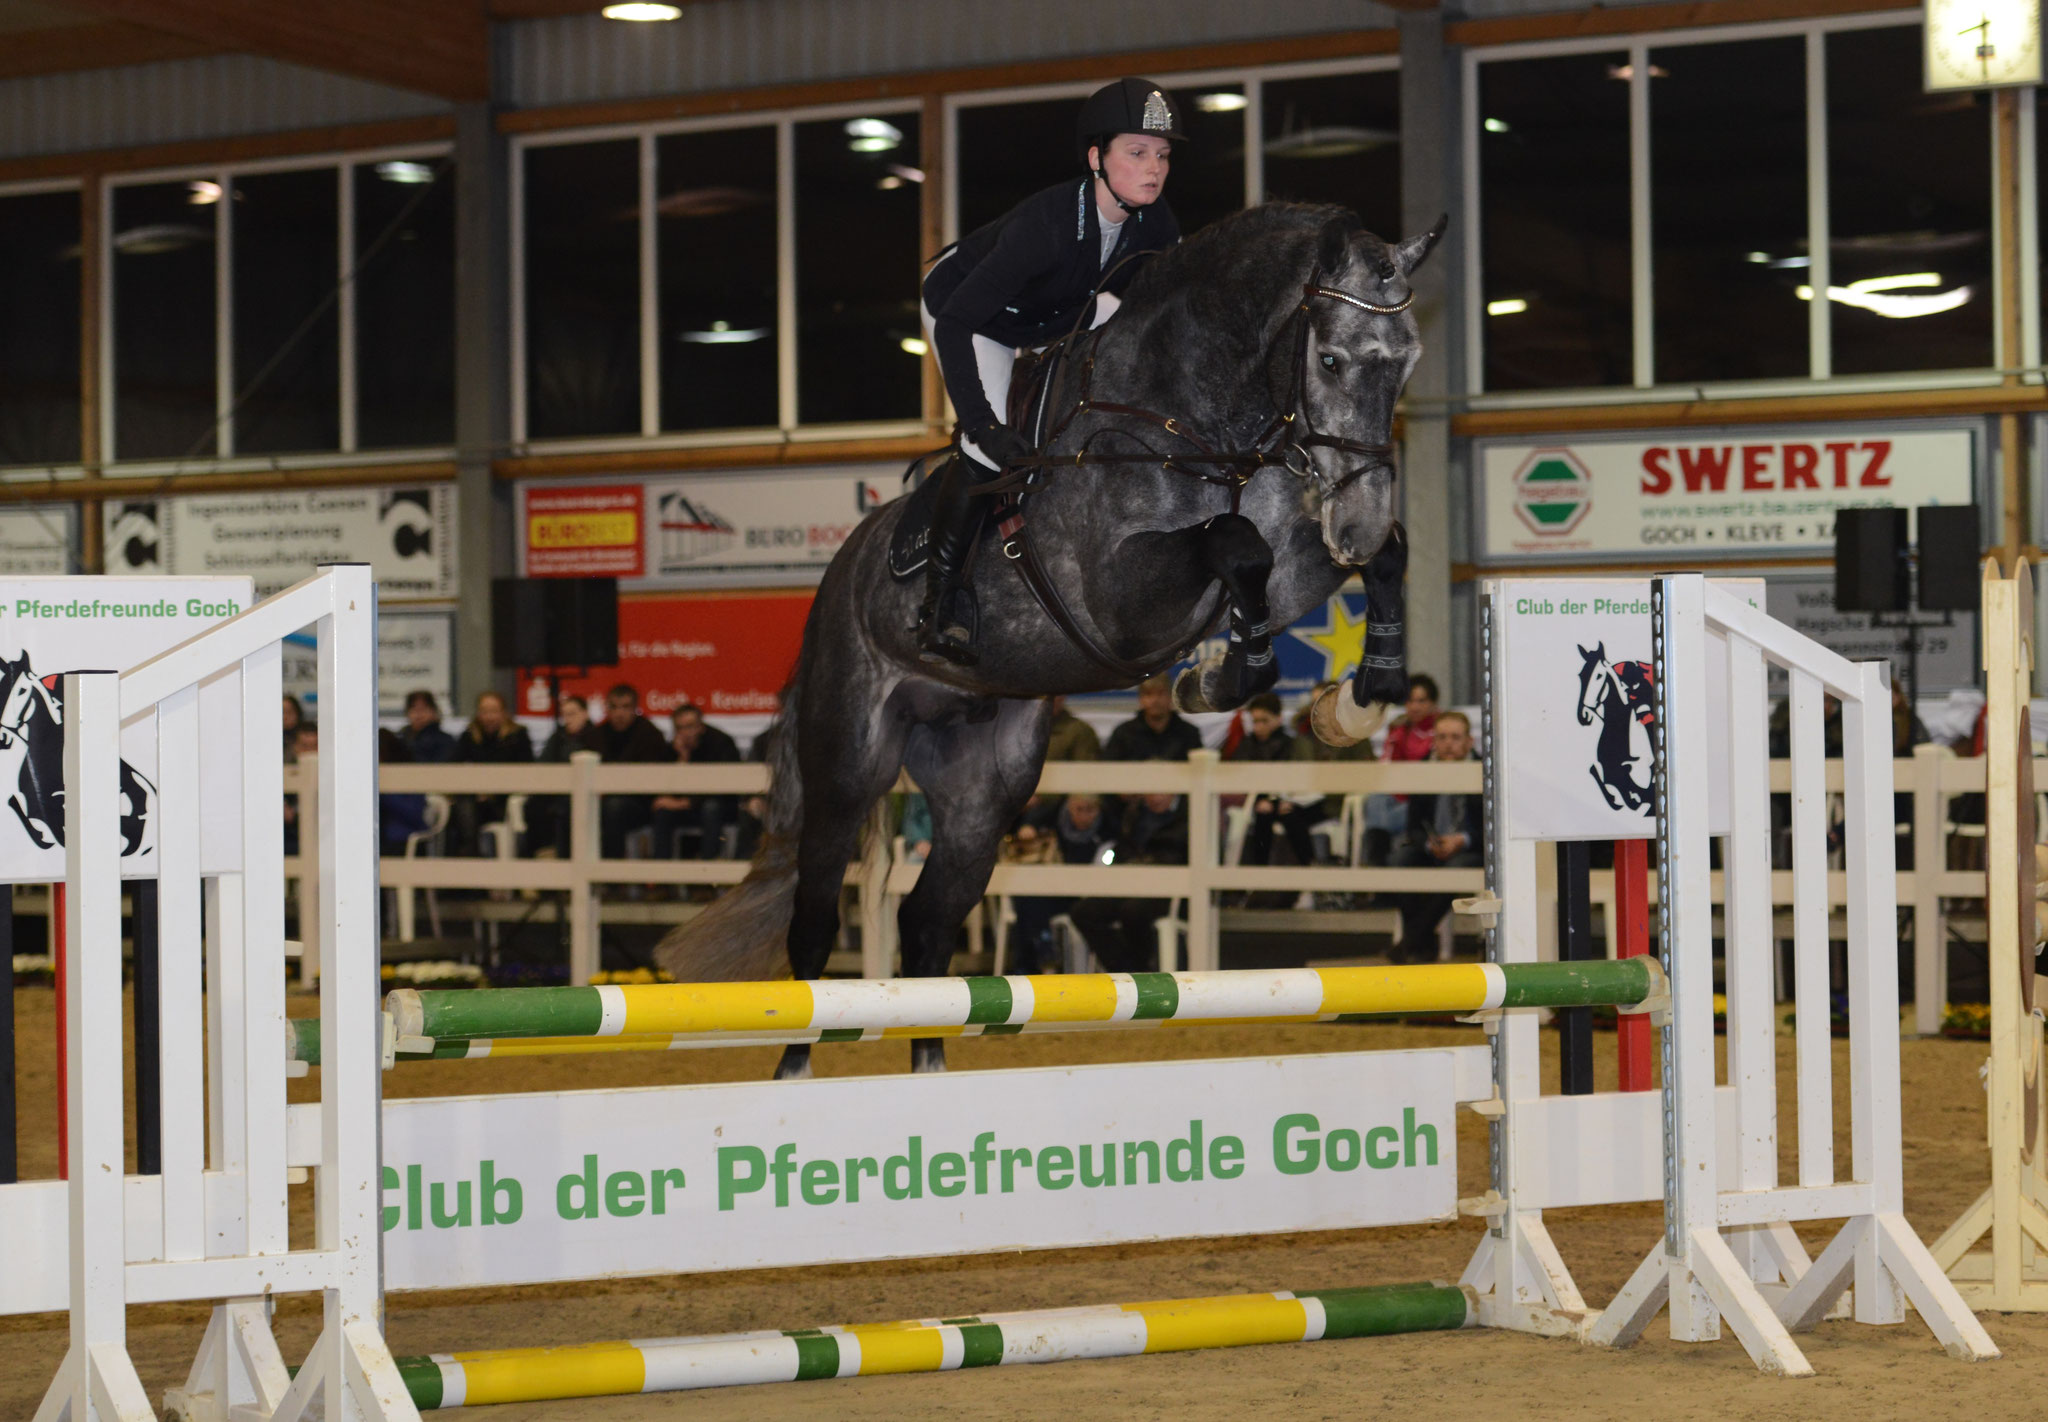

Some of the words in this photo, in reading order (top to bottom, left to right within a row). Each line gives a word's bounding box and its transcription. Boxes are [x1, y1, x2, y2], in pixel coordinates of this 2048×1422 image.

[1640, 440, 1893, 496] SWERTZ
[1641, 524, 1697, 545] GOCH
[1725, 521, 1785, 542] KLEVE
[15, 599, 178, 618] Pferdefreunde
[185, 598, 241, 617] Goch
[1516, 598, 1554, 615] Club
[1560, 598, 1588, 615] der
[555, 1154, 687, 1221] der
[716, 1119, 1246, 1212] Pferdefreunde
[1272, 1106, 1439, 1176] Goch
